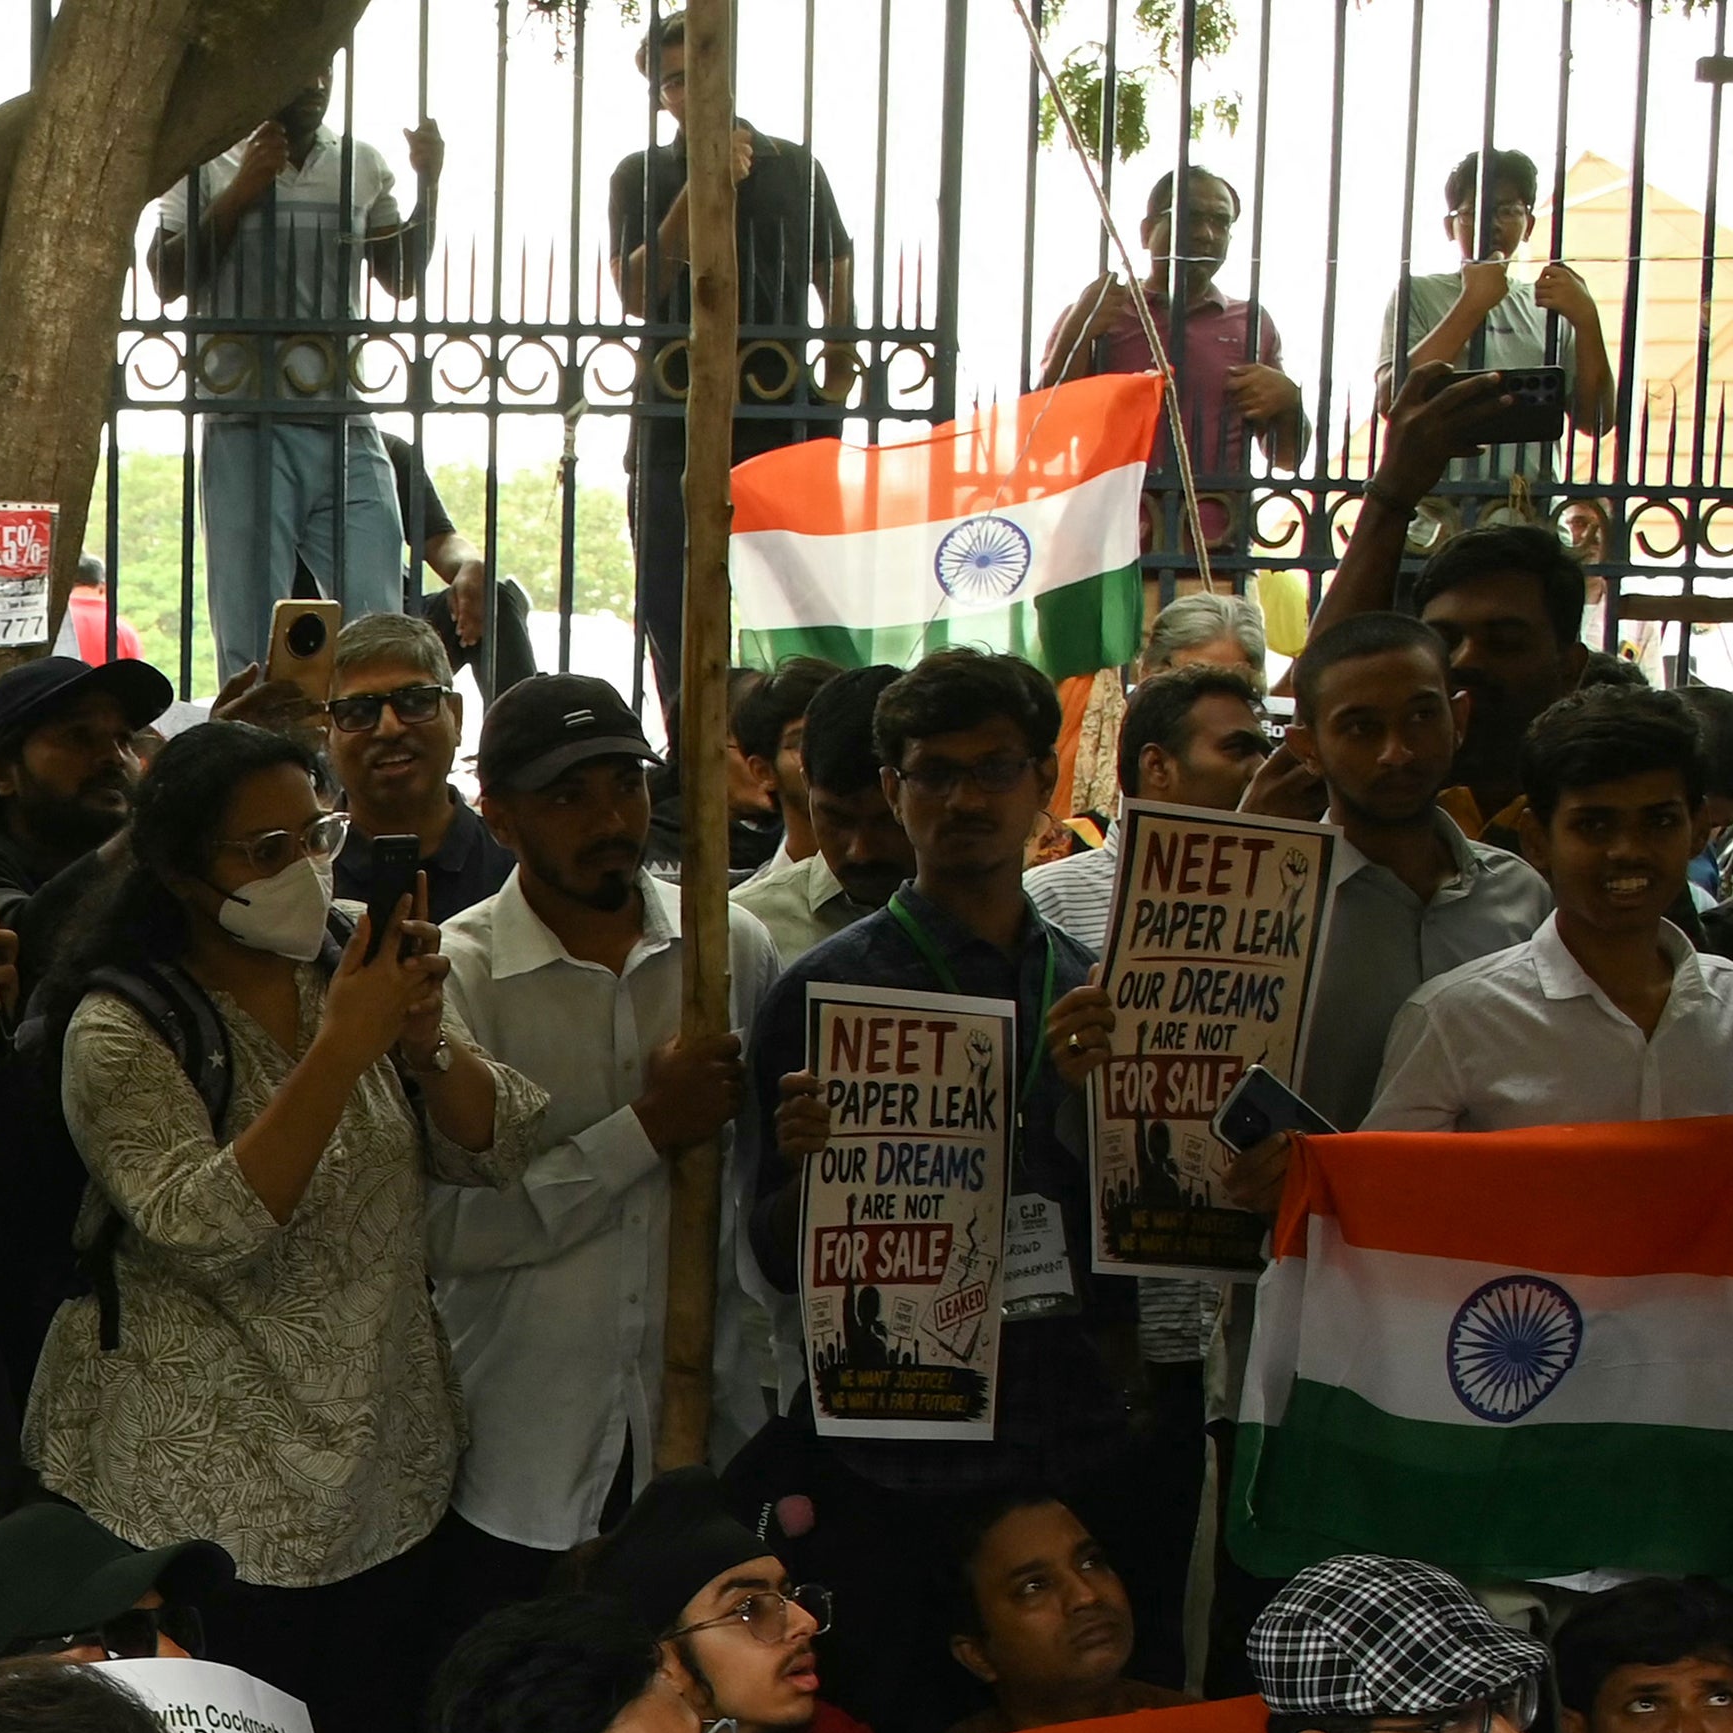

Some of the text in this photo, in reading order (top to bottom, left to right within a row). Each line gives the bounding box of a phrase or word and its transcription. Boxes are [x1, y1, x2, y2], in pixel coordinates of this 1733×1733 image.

[1142, 831, 1275, 898] NEET
[1129, 900, 1305, 957] PAPER LEAK
[1117, 967, 1284, 1023] OUR DREAMS
[831, 1016, 958, 1075] NEET
[1150, 1022, 1237, 1051] ARE NOT
[827, 1080, 997, 1131] PAPER LEAK
[1109, 1061, 1158, 1113] FOR
[821, 1142, 985, 1192] OUR DREAMS
[861, 1194, 944, 1220] ARE NOT
[820, 1230, 947, 1282] FOR SALE
[938, 1288, 983, 1324] LEAKED
